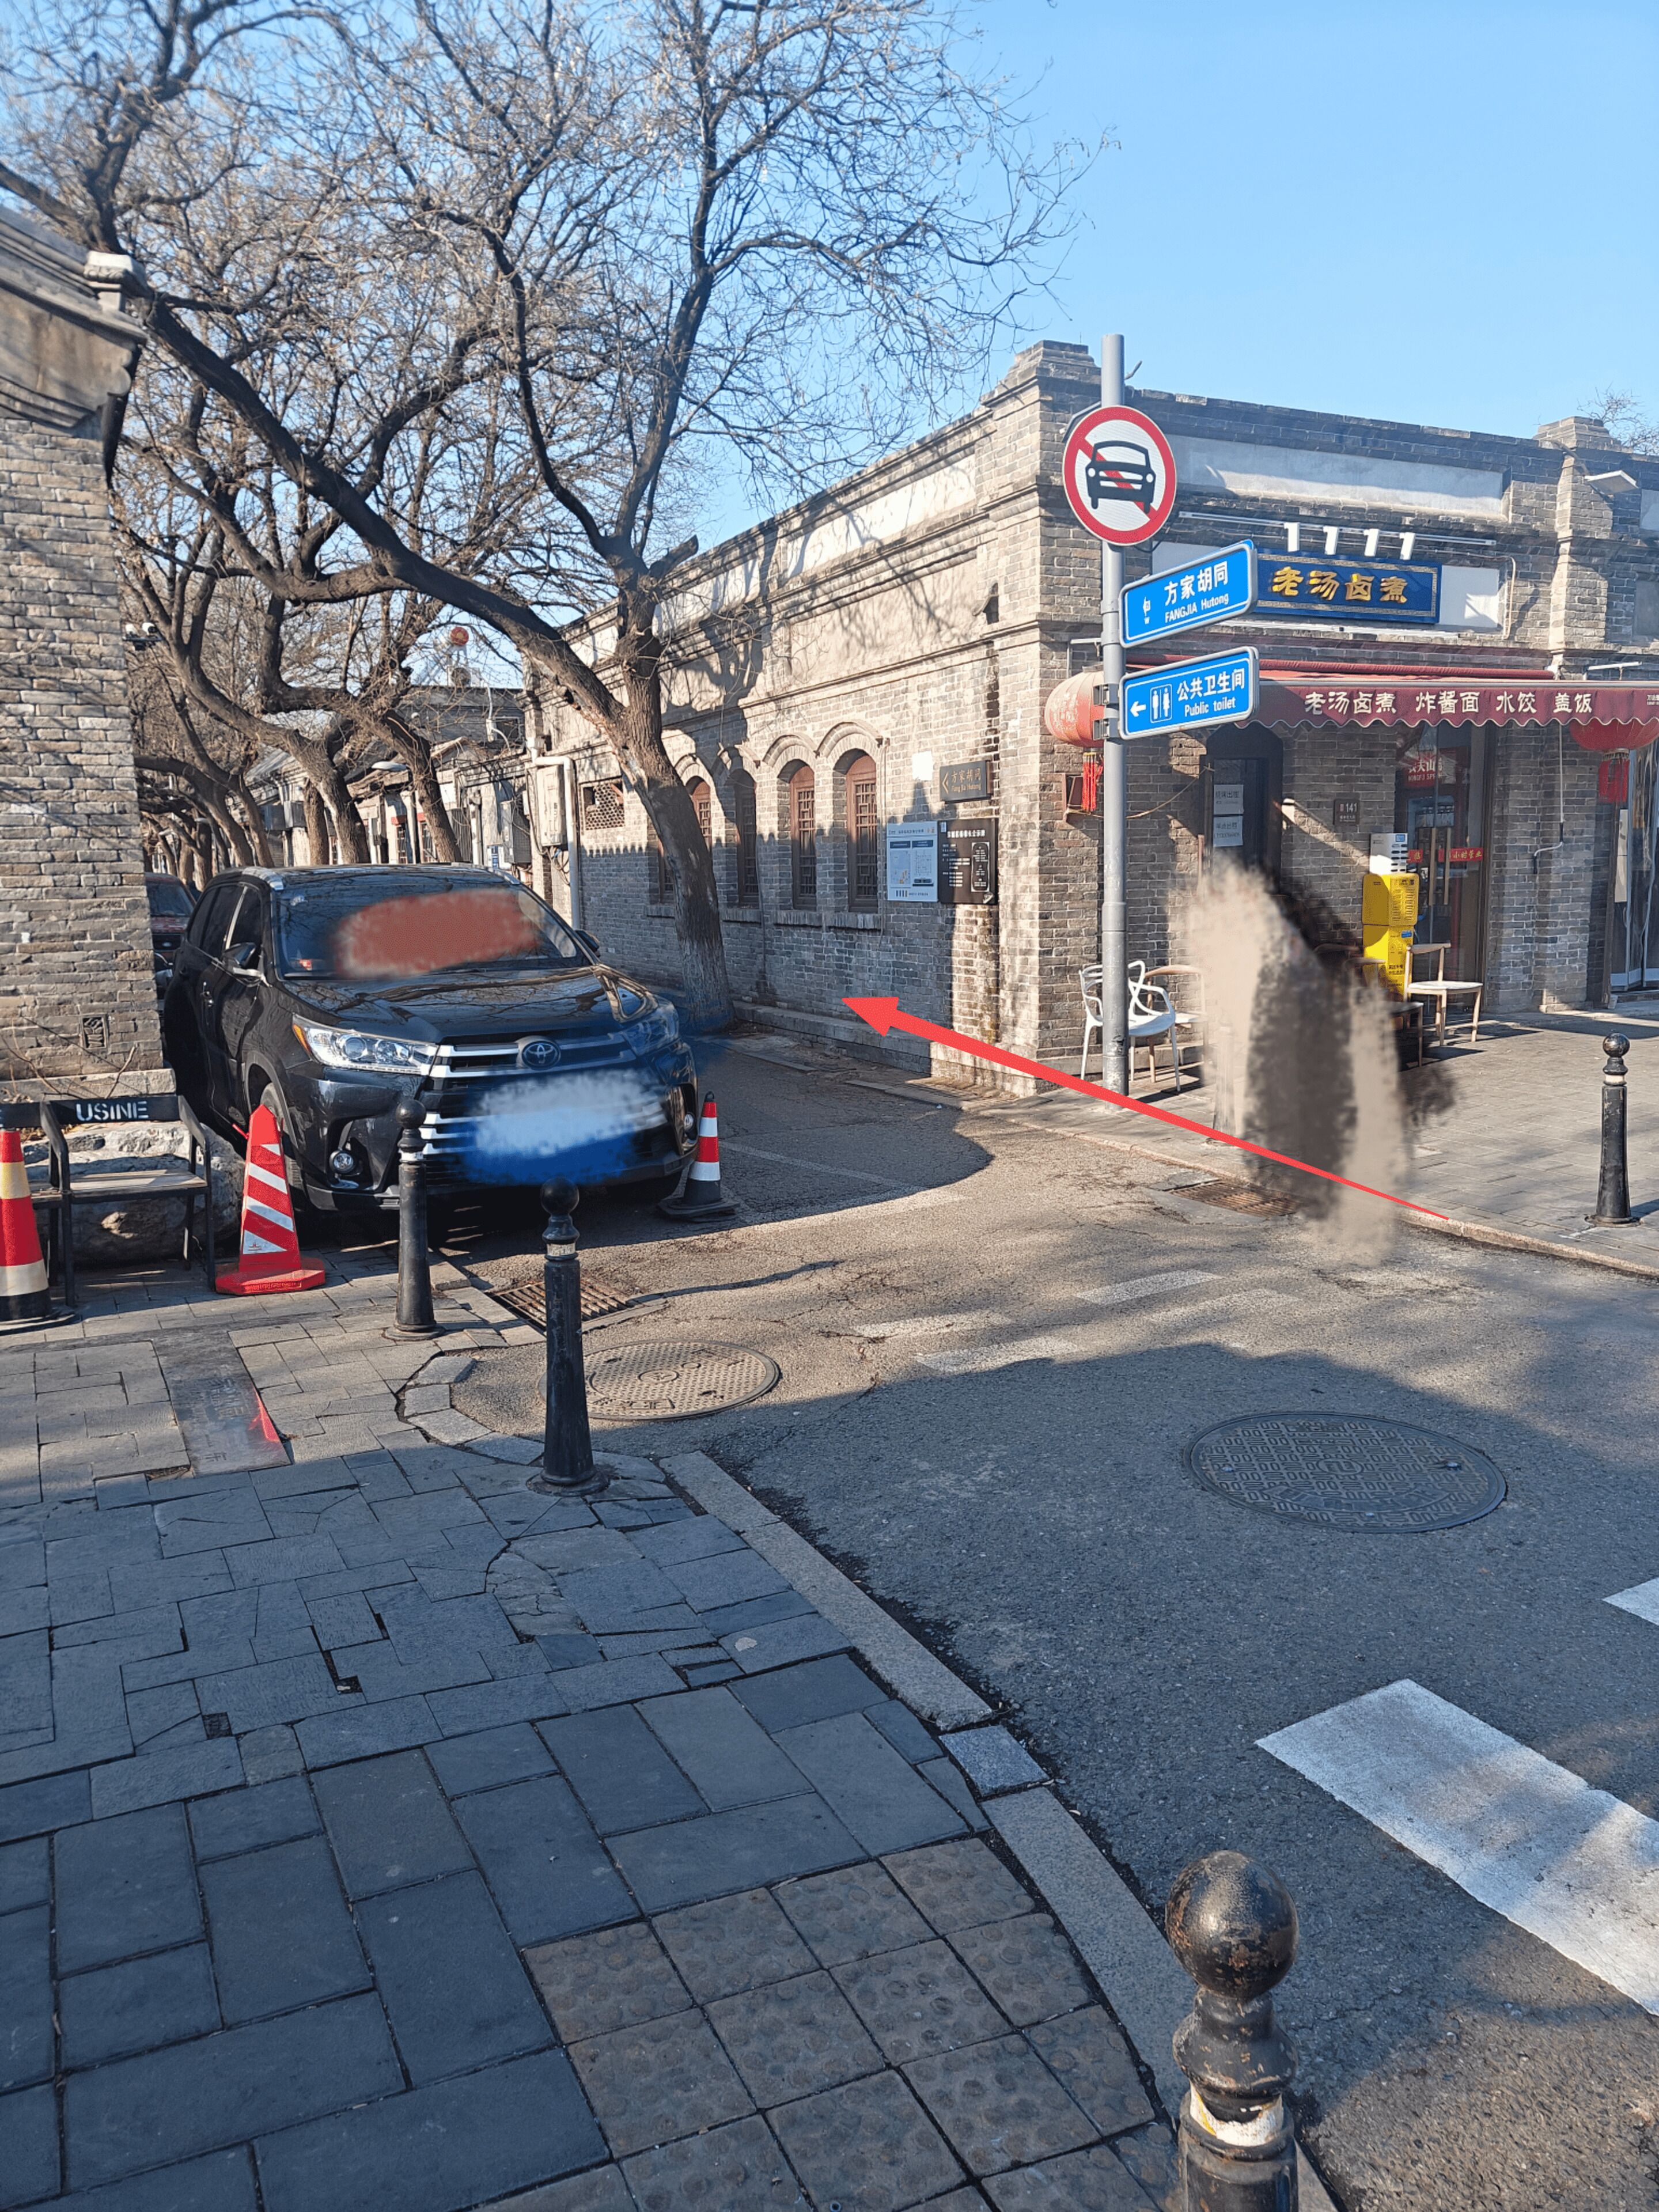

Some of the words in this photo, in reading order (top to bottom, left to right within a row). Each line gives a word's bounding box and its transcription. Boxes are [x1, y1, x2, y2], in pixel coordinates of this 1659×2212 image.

[1164, 560, 1228, 606] 方家胡同
[1272, 566, 1408, 604] 老汤卤煮
[1165, 602, 1198, 623] FANGJIA
[1201, 593, 1229, 609] Hutong
[1177, 668, 1245, 701] 公共卫生间
[1184, 698, 1209, 717] Public
[1213, 696, 1236, 711] toilet
[1304, 691, 1397, 715] 老汤卤煮
[1415, 690, 1480, 714] 炸酱面
[1496, 691, 1537, 714] 水饺
[1553, 692, 1593, 713] 盖饭
[76, 1101, 149, 1121] USINE
